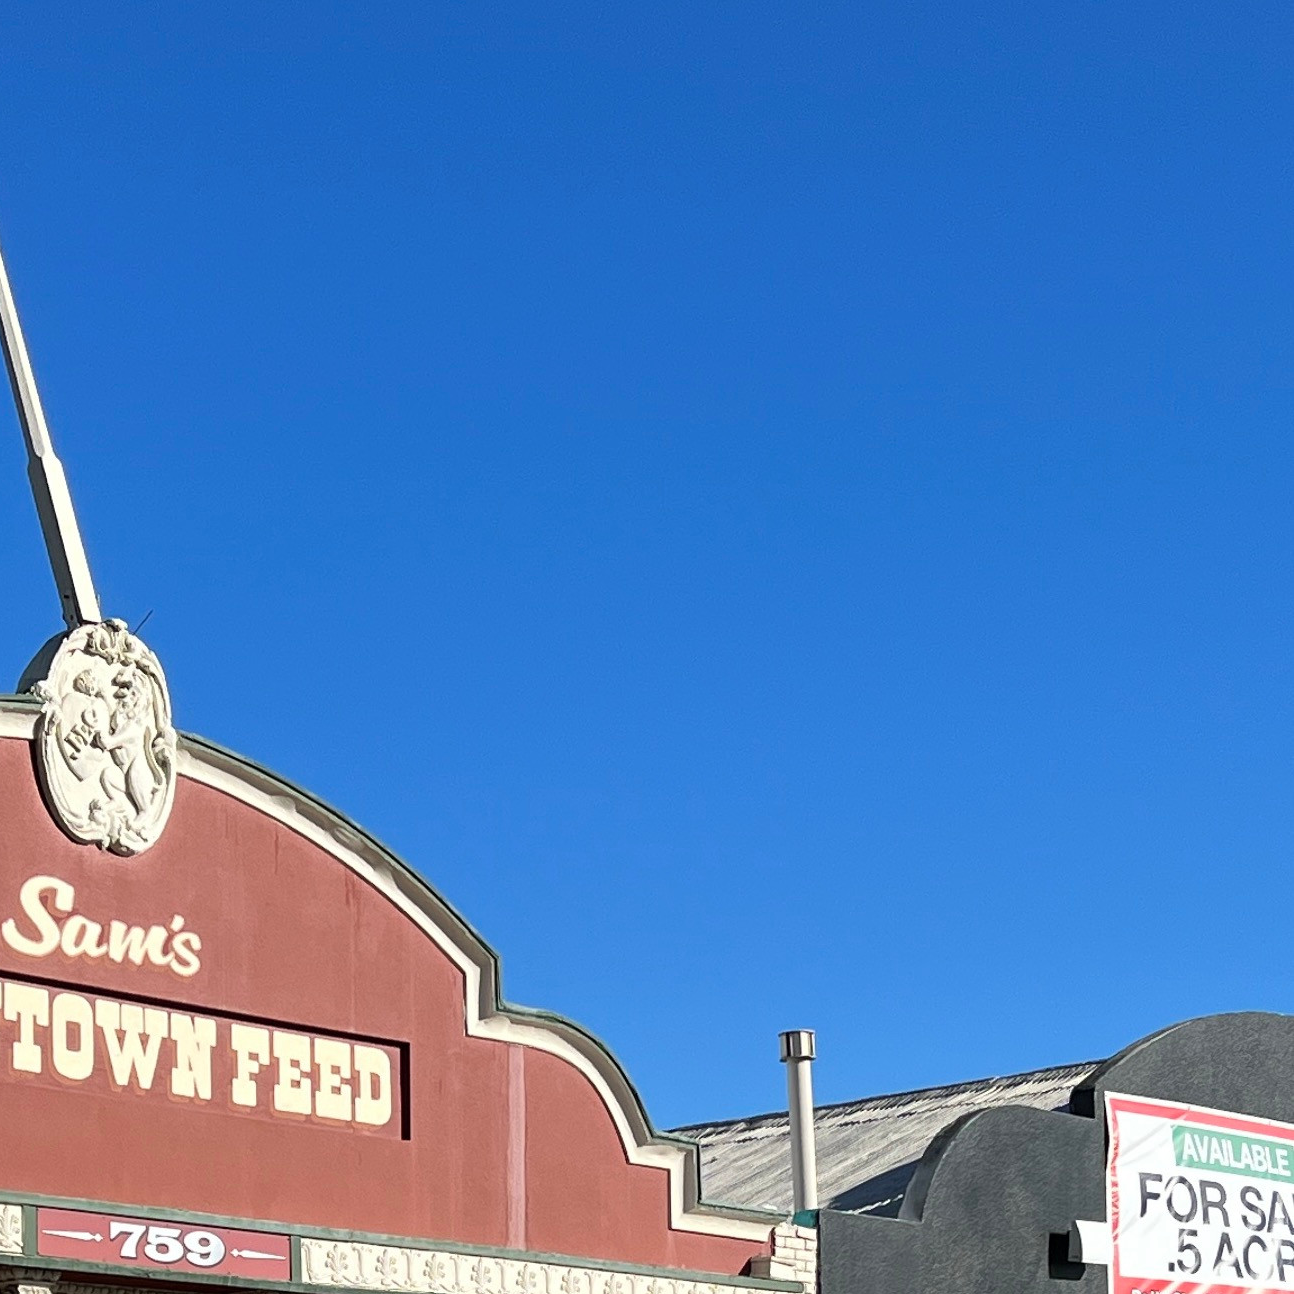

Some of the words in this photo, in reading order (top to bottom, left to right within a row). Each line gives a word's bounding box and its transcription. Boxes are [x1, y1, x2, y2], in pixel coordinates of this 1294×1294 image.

[2, 875, 202, 977] Sam's
[231, 1023, 392, 1126] FEED
[1182, 1133, 1292, 1177] AVAILABLE
[1138, 1172, 1231, 1228] FOR
[1239, 1185, 1294, 1236] SA
[109, 1221, 226, 1267] 759
[1168, 1228, 1203, 1275] .5
